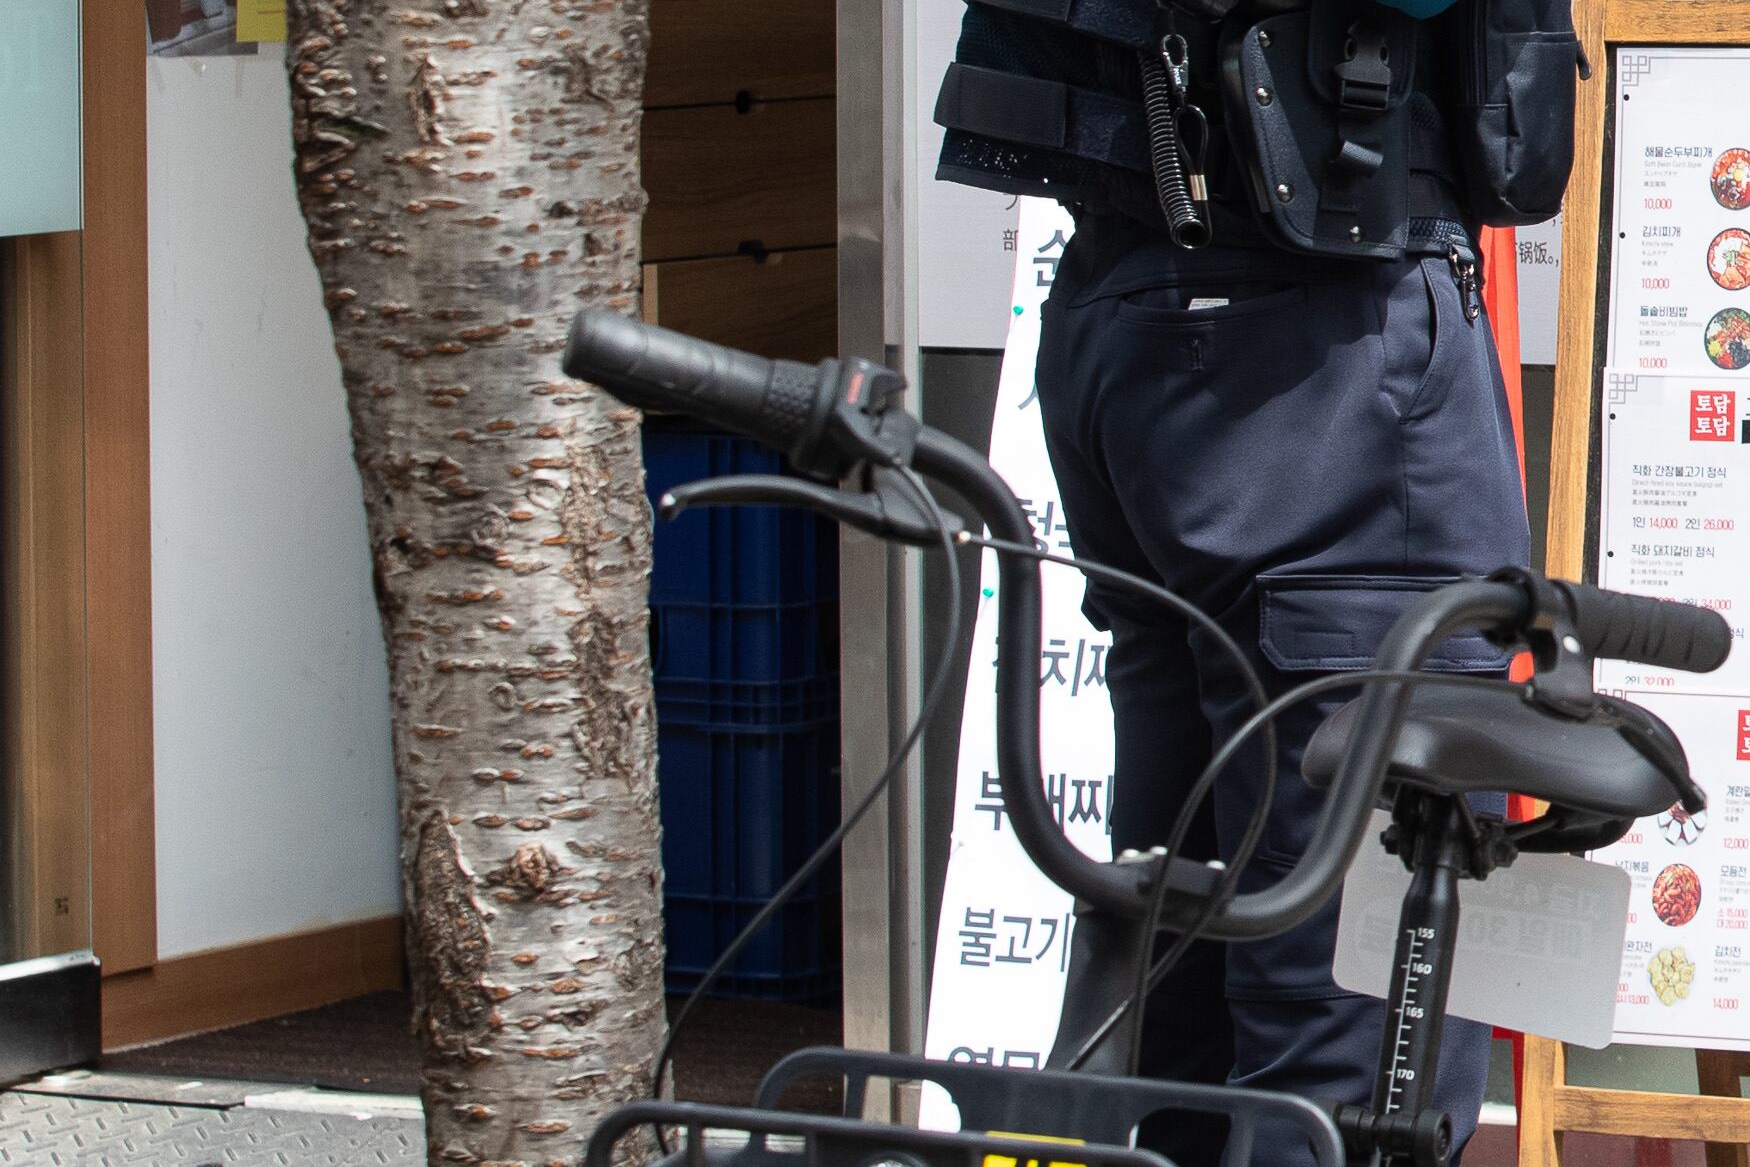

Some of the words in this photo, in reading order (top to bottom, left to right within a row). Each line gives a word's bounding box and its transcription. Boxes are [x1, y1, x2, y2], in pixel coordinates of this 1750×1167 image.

[1644, 146, 1713, 158] 해물순두부찌개
[1644, 198, 1673, 210] 10,000
[1642, 226, 1681, 238] 김치찌개
[1641, 278, 1670, 290] 10,000
[1640, 306, 1688, 318] 돌솥비빔밥
[1639, 357, 1668, 369] 10,000
[1695, 394, 1731, 414] 토담
[1695, 415, 1730, 437] 토담
[1632, 464, 1652, 476] 직화
[1655, 465, 1704, 478] 간장불고기
[1706, 466, 1727, 479] 정식
[1632, 516, 1645, 528] 1인
[1649, 517, 1678, 530] 14,000
[1685, 518, 1700, 530] 2인
[1704, 519, 1734, 531] 26,000
[1631, 544, 1651, 556] 직화
[1654, 545, 1693, 557] 돼지갈비
[1696, 546, 1715, 558] 정식
[1723, 837, 1749, 850] 12,000
[958, 906, 1071, 972] 불고기
[1417, 927, 1435, 939] 155
[1715, 946, 1742, 958] 김치전
[1412, 962, 1432, 974] 160
[1713, 998, 1738, 1010] 14,000
[1405, 1006, 1424, 1018] 165
[1396, 1068, 1415, 1080] 170
